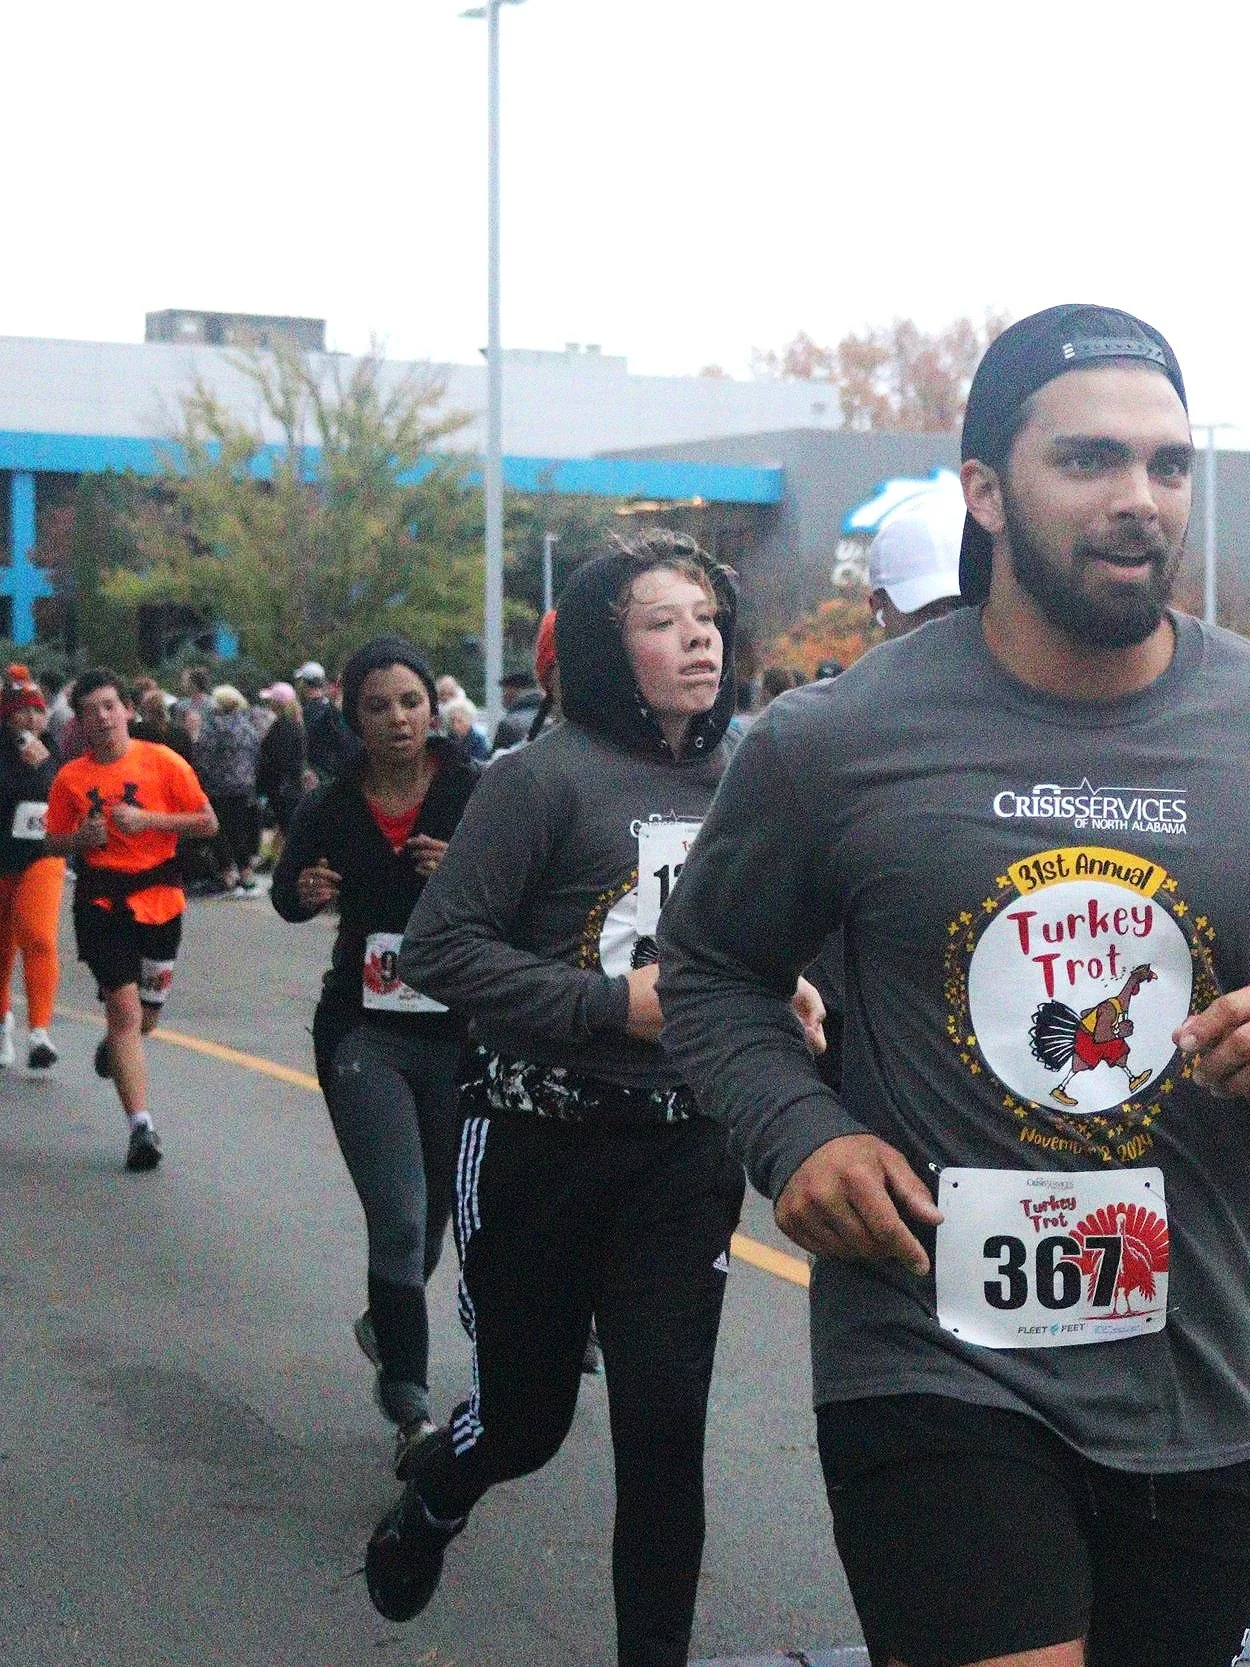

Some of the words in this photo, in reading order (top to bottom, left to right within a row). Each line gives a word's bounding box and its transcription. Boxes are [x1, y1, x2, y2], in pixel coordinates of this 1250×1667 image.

[1074, 819, 1088, 829] OF
[1092, 820, 1128, 830] NORTH
[1131, 822, 1187, 834] ALABAMA
[1018, 853, 1070, 890] 31st
[1075, 853, 1154, 890] Annual
[1007, 899, 1153, 955] Turkey
[1032, 944, 1121, 998] Trot
[1019, 1195, 1077, 1217] Turkey
[1029, 1212, 1068, 1233] Trot
[983, 1235, 1122, 1310] 367
[1017, 1326, 1048, 1335] FLEET
[1061, 1322, 1086, 1333] FEET
